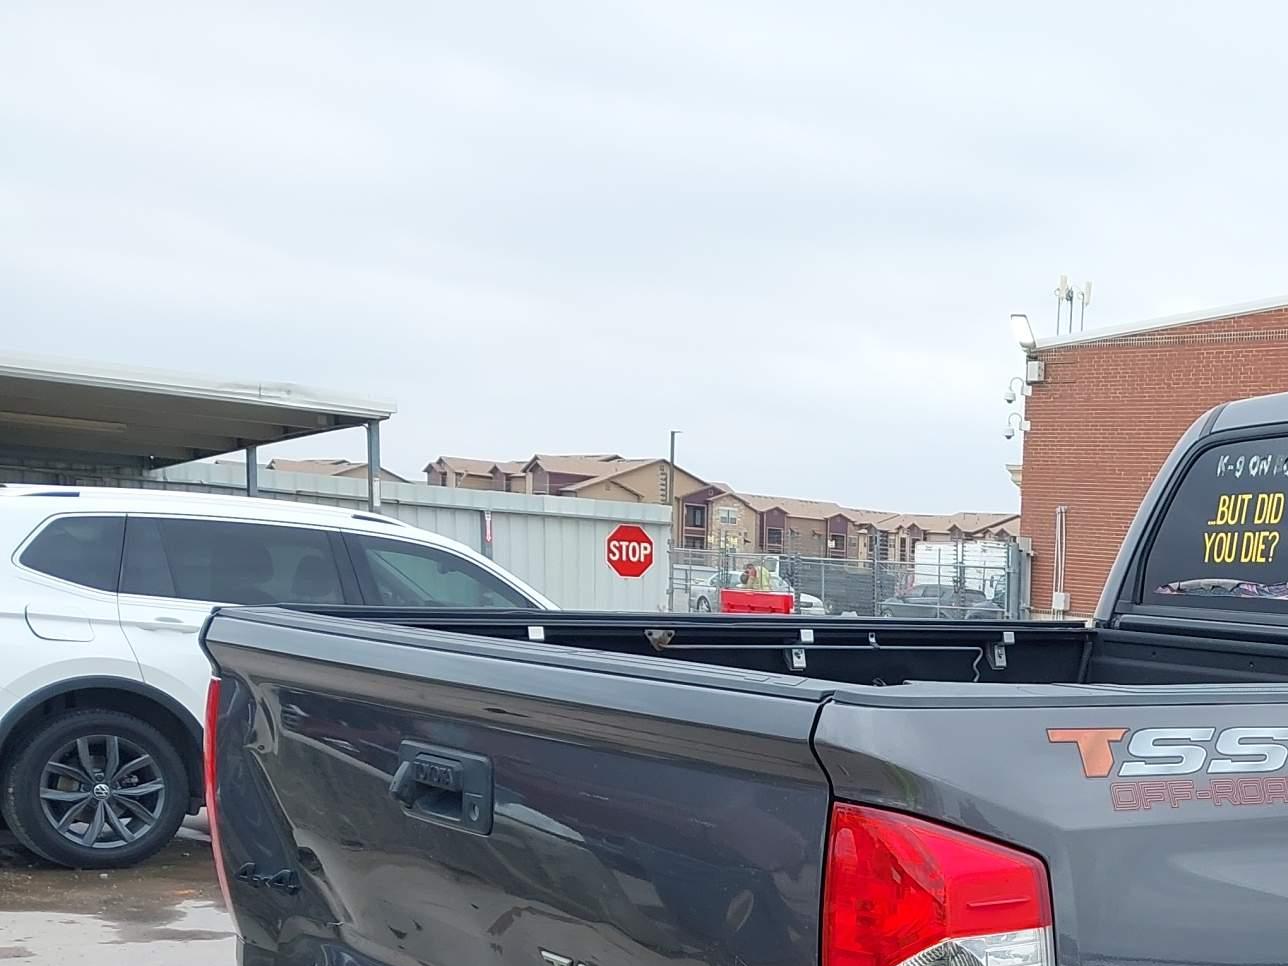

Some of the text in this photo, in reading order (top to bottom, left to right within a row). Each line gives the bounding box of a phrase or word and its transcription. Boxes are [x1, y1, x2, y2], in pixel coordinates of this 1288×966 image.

[1217, 455, 1245, 478] K-9
[1248, 455, 1272, 476] ON
[1254, 493, 1285, 525] DID
[608, 540, 651, 562] STOP
[1204, 531, 1280, 562] YOU DIE?
